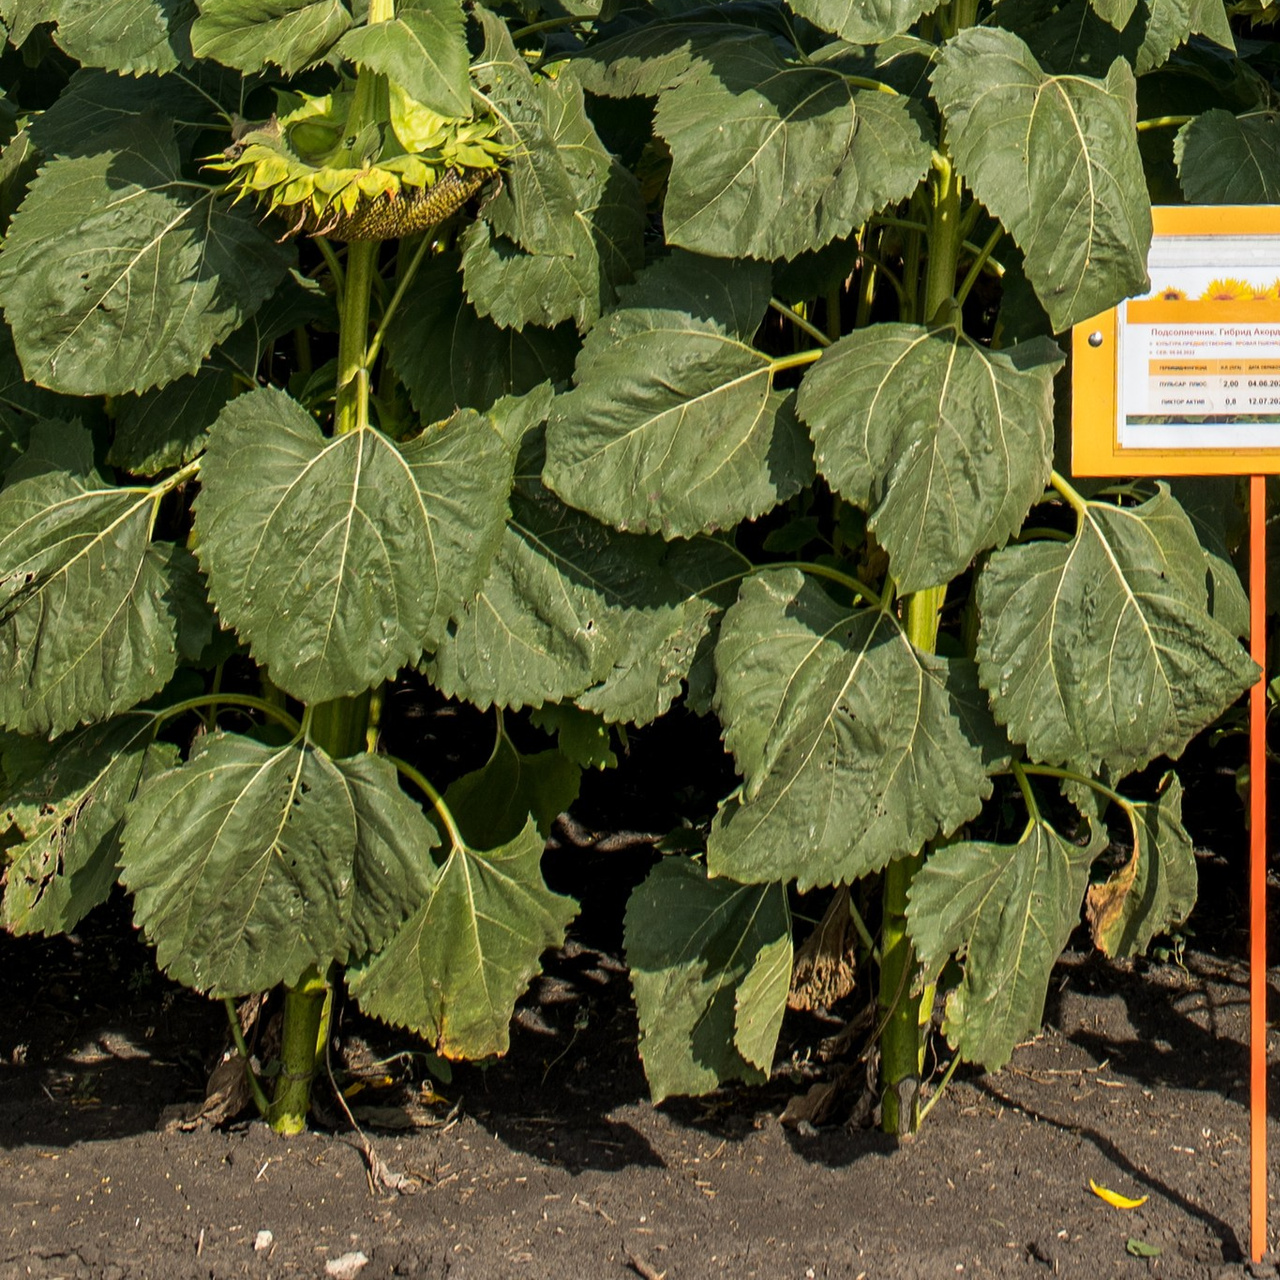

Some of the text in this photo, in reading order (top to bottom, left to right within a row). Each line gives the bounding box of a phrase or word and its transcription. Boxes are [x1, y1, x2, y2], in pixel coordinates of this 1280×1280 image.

[1151, 328, 1217, 337] Подсолнечник.
[1219, 328, 1252, 337] Гибрид
[1223, 380, 1239, 388] 2,00
